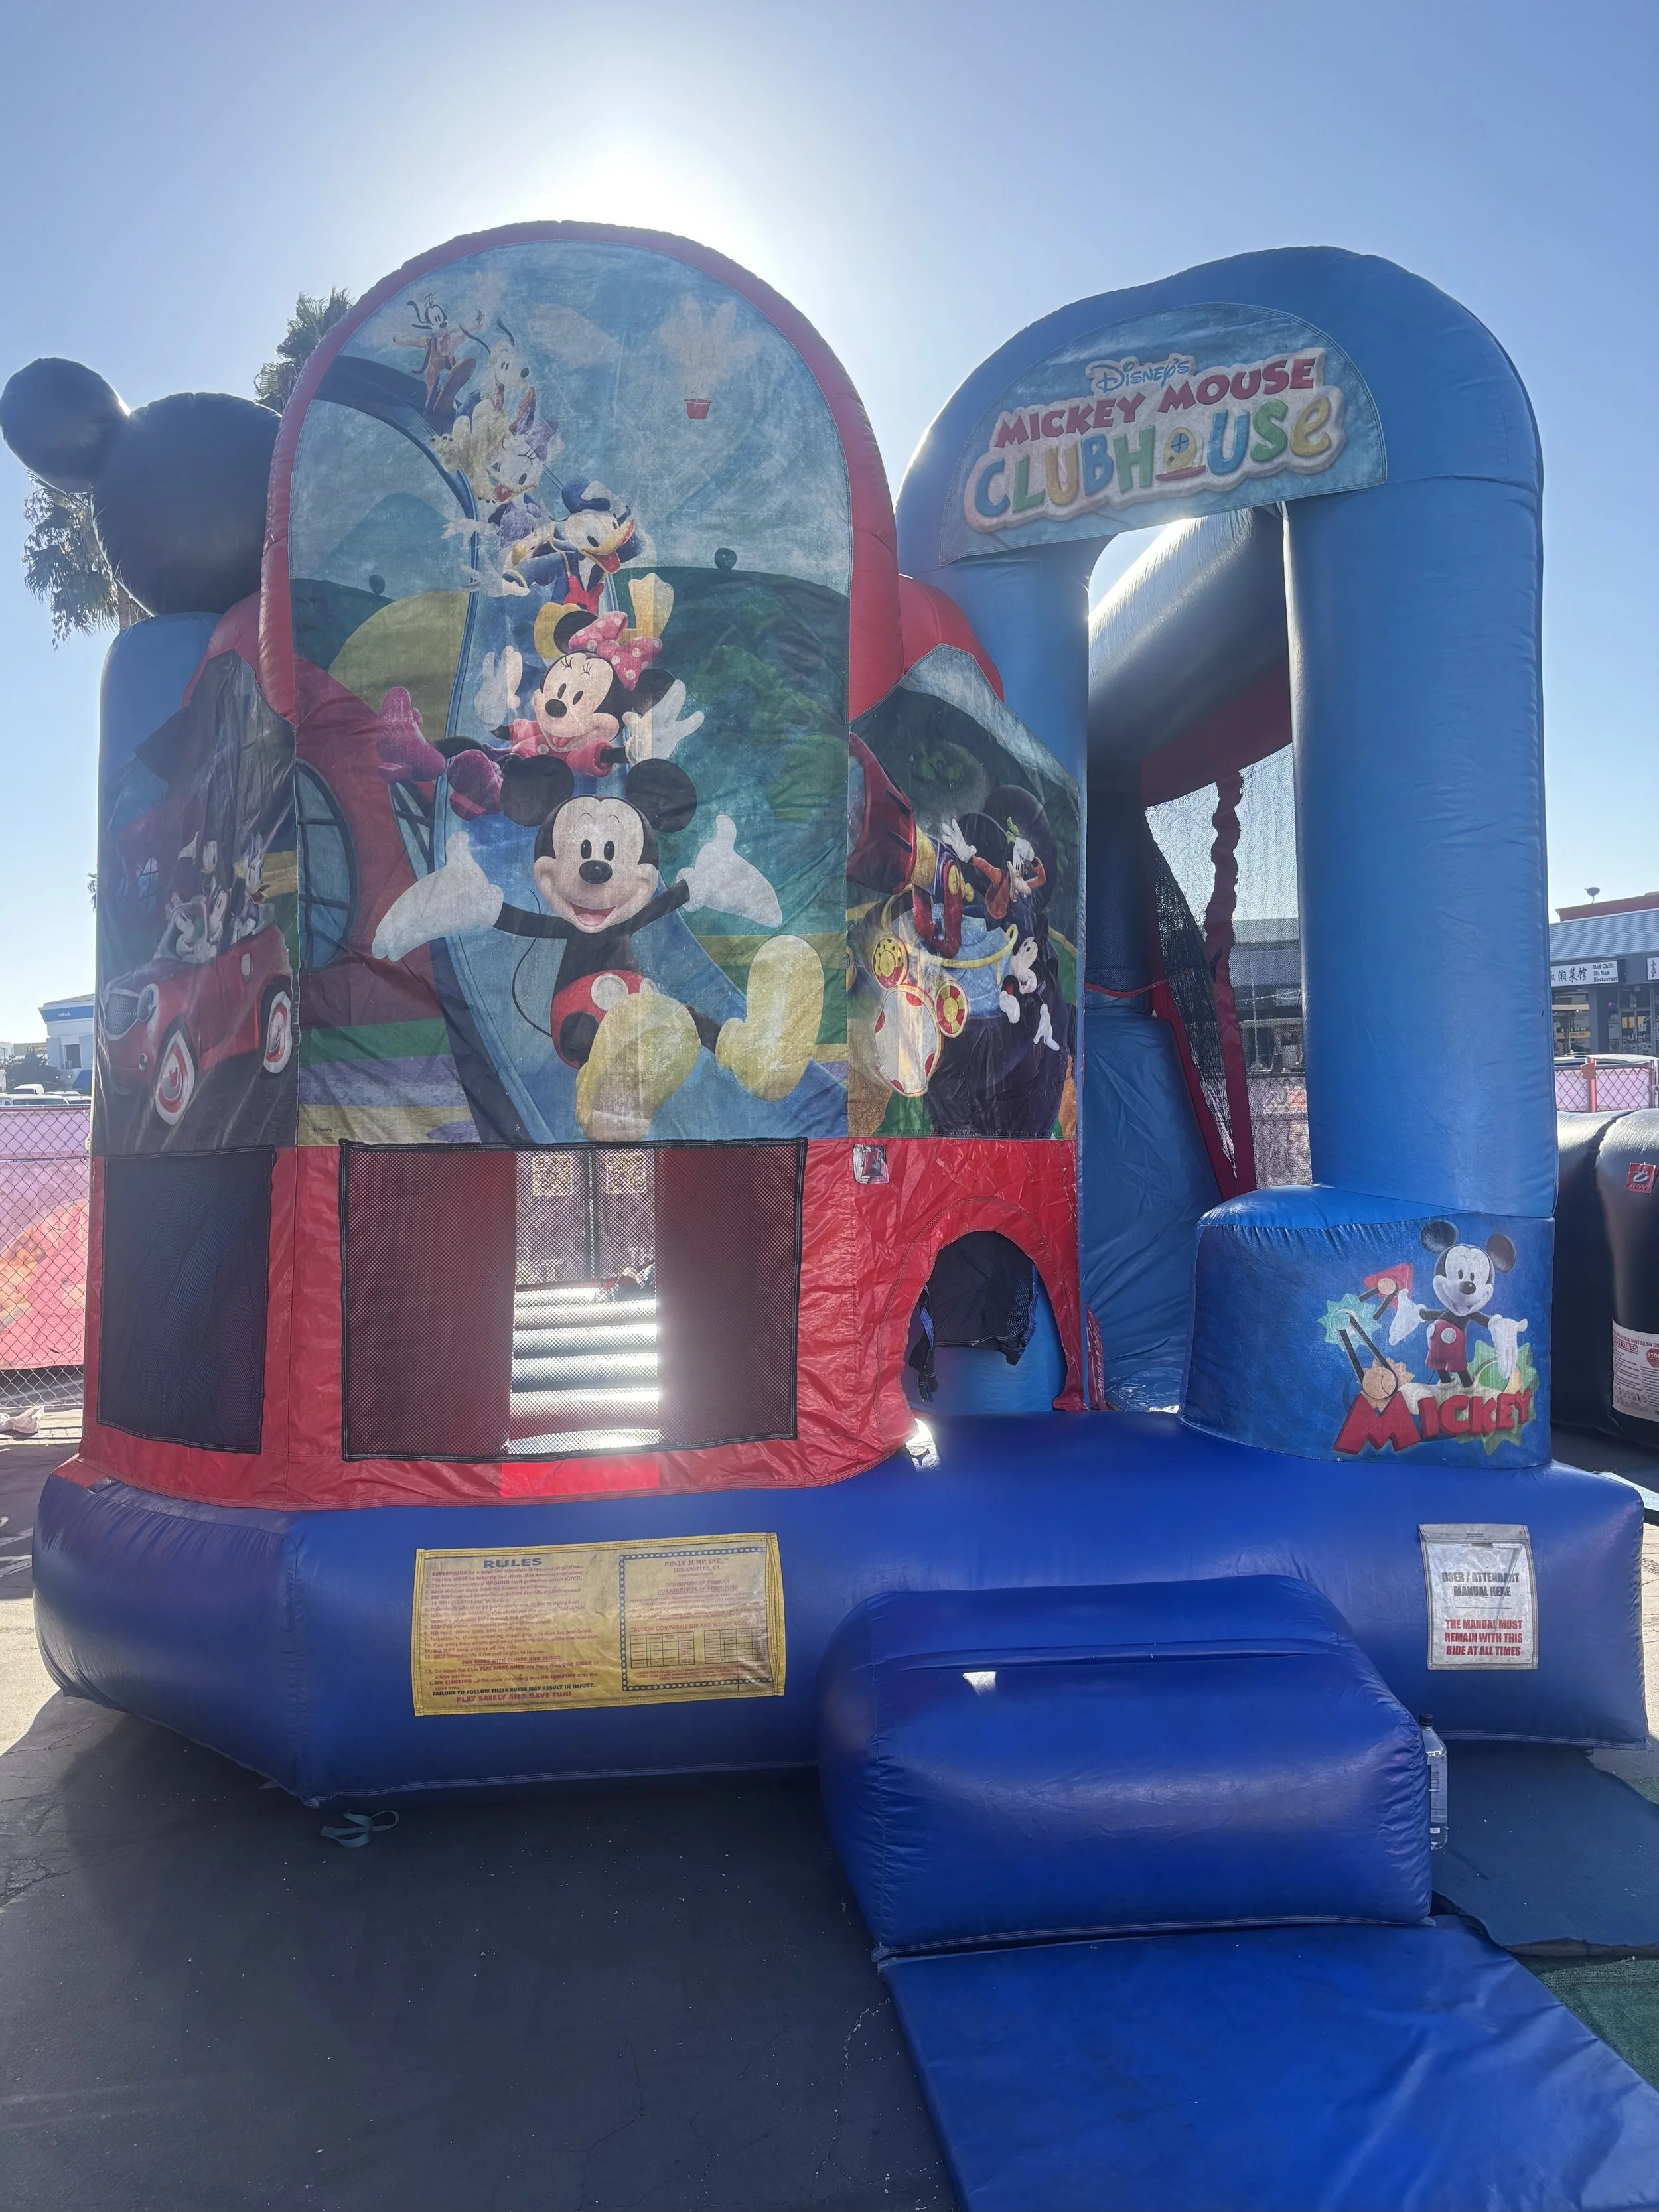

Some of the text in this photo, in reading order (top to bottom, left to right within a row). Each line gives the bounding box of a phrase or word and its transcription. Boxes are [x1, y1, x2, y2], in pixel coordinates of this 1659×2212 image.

[994, 357, 1315, 448] MICKEY MOUSE
[1333, 1389, 1532, 1454] MICKEY
[483, 1558, 542, 1568] RULES
[1441, 1572, 1465, 1583] USER
[1453, 1586, 1511, 1596] MANUAL HERE
[1445, 1619, 1522, 1629] THE MANUAL MUST
[1445, 1632, 1522, 1643] REMAIN WITH THIS
[1446, 1645, 1521, 1656] RIDE AT ALL TIMES
